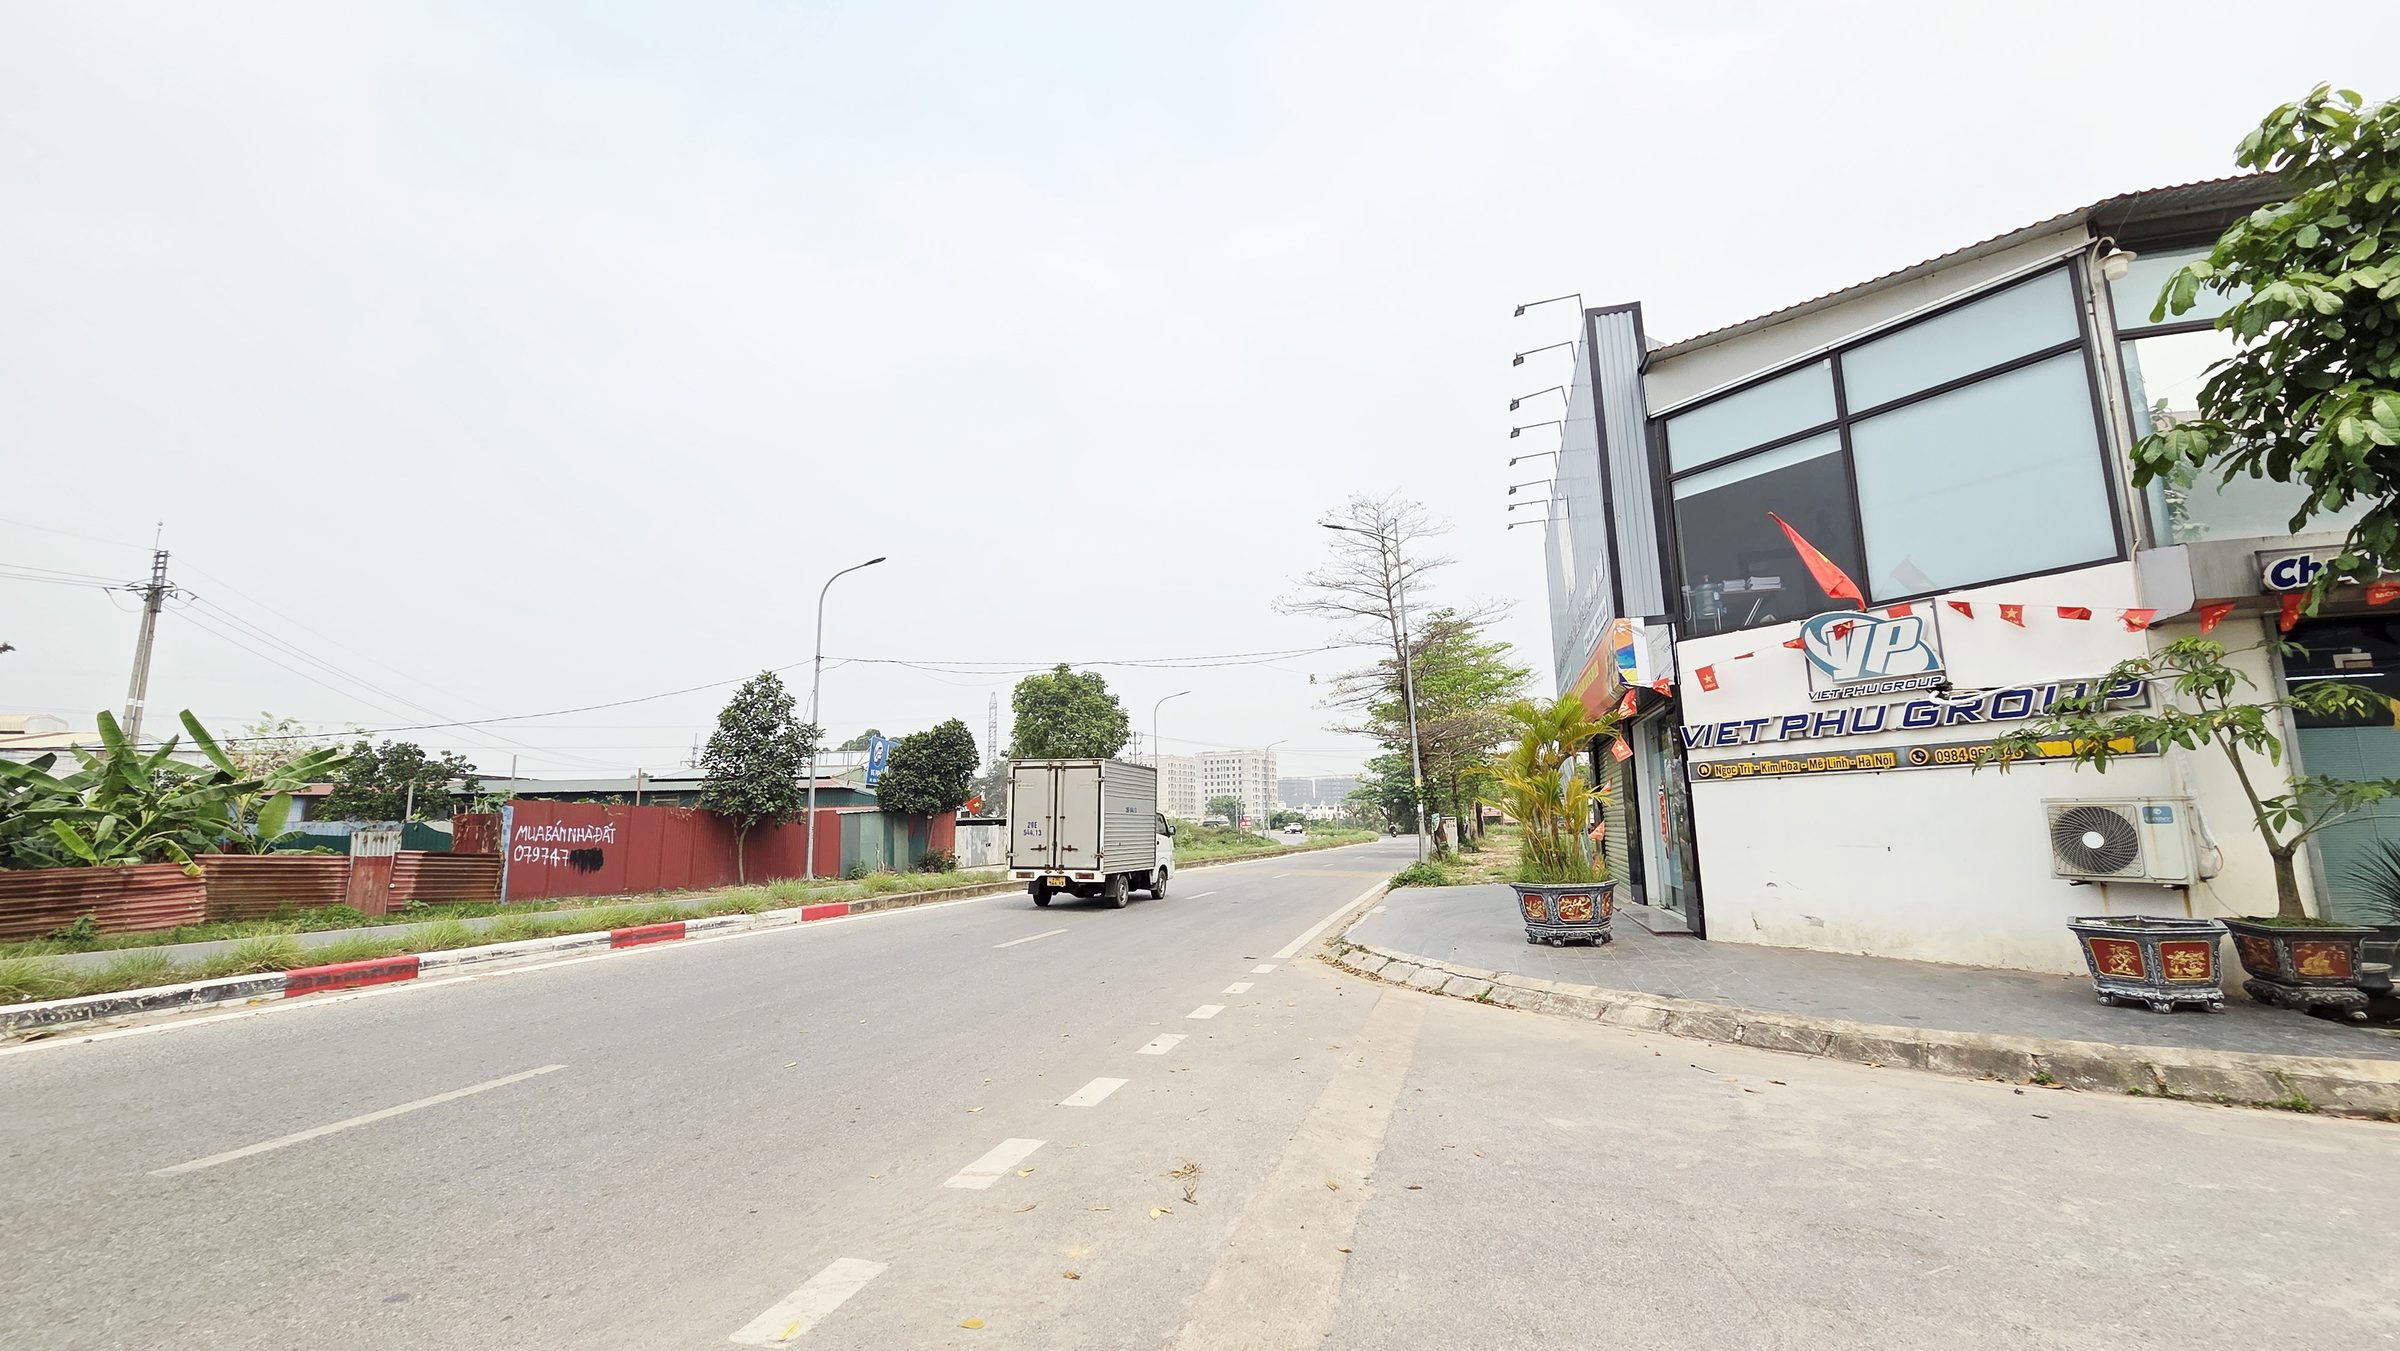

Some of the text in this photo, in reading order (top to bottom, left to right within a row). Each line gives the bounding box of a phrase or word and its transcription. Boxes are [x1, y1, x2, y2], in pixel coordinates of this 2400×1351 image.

[1808, 675, 1945, 701] VIET PHU GROUP
[1681, 678, 2144, 749] VIET PHU GROUP
[1761, 761, 1779, 773] Kim
[1780, 761, 1799, 772] Hoa
[1808, 758, 1825, 770] Mê
[1827, 756, 1848, 769] Linh
[1875, 753, 1893, 768] Nội
[1936, 748, 1967, 763] 0984
